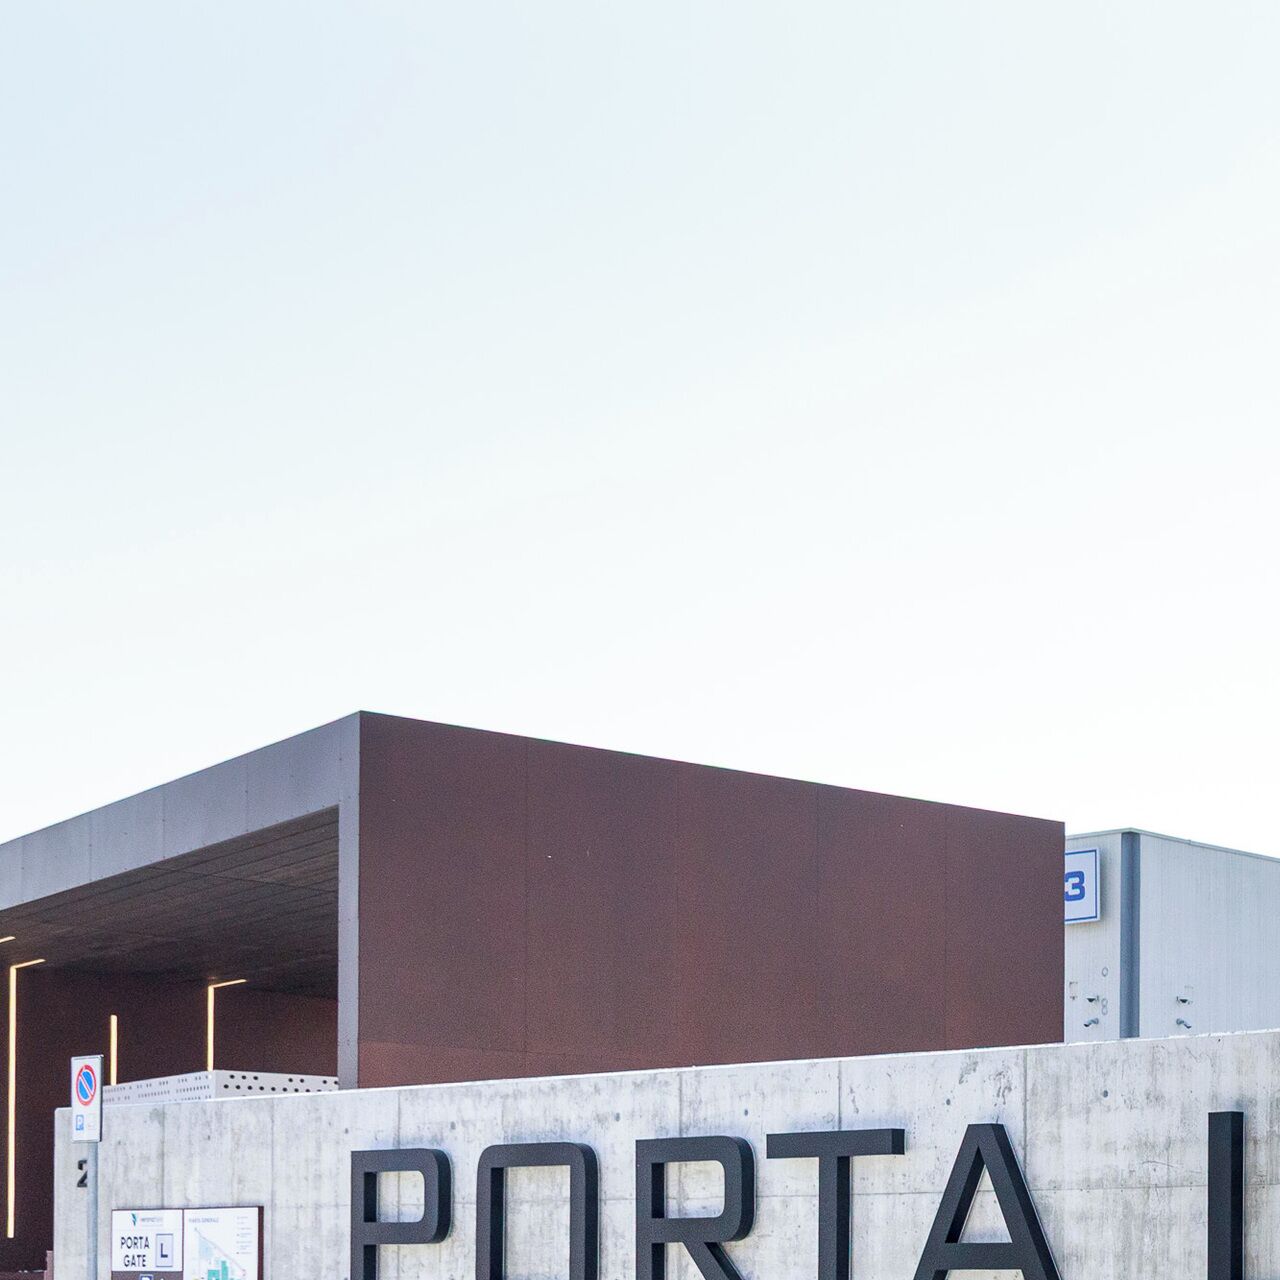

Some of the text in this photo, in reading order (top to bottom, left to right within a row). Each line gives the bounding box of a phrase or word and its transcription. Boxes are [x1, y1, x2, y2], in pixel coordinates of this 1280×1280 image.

[1064, 871, 1086, 902] 3
[121, 1236, 150, 1250] PORTA
[160, 1243, 168, 1258] L
[123, 1254, 147, 1268] GATE
